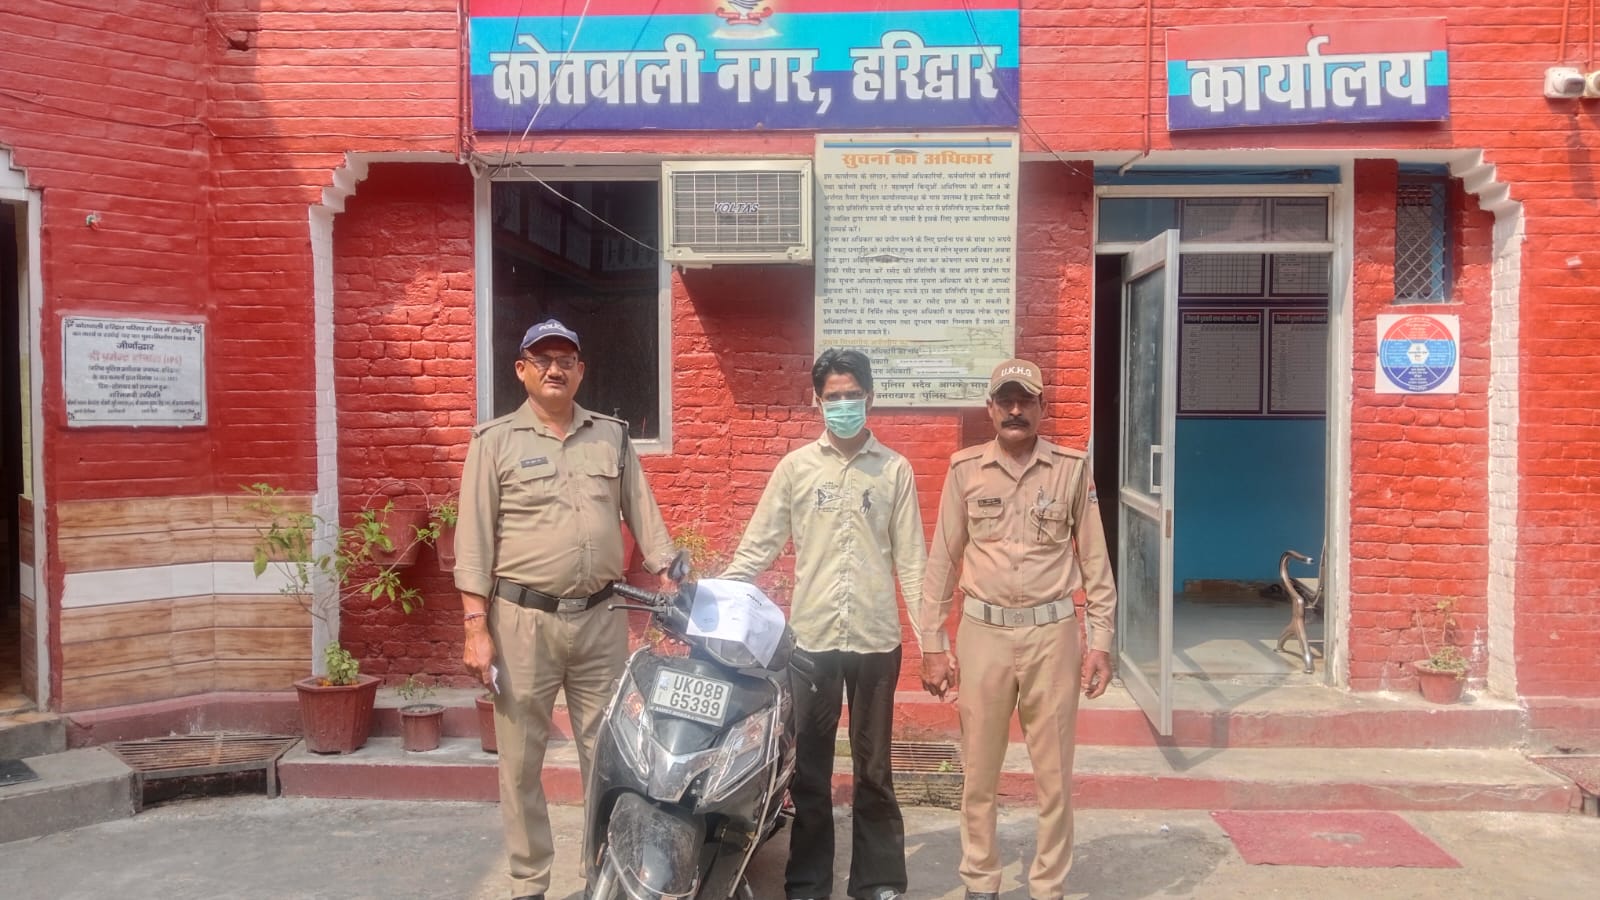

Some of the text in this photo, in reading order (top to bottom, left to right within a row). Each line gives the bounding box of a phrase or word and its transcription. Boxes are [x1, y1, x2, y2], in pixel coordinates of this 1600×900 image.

[490, 30, 1001, 114] कोतवाली नगर, हरिद्वार
[1186, 35, 1432, 112] कार्यालय
[895, 153, 917, 165] का
[923, 150, 993, 165] अधिकार
[714, 202, 759, 213] VOLTAS
[881, 380, 905, 390] पुलिस
[922, 390, 946, 401] पुलिस
[674, 676, 723, 700] UK08B
[670, 692, 720, 716] G5399
